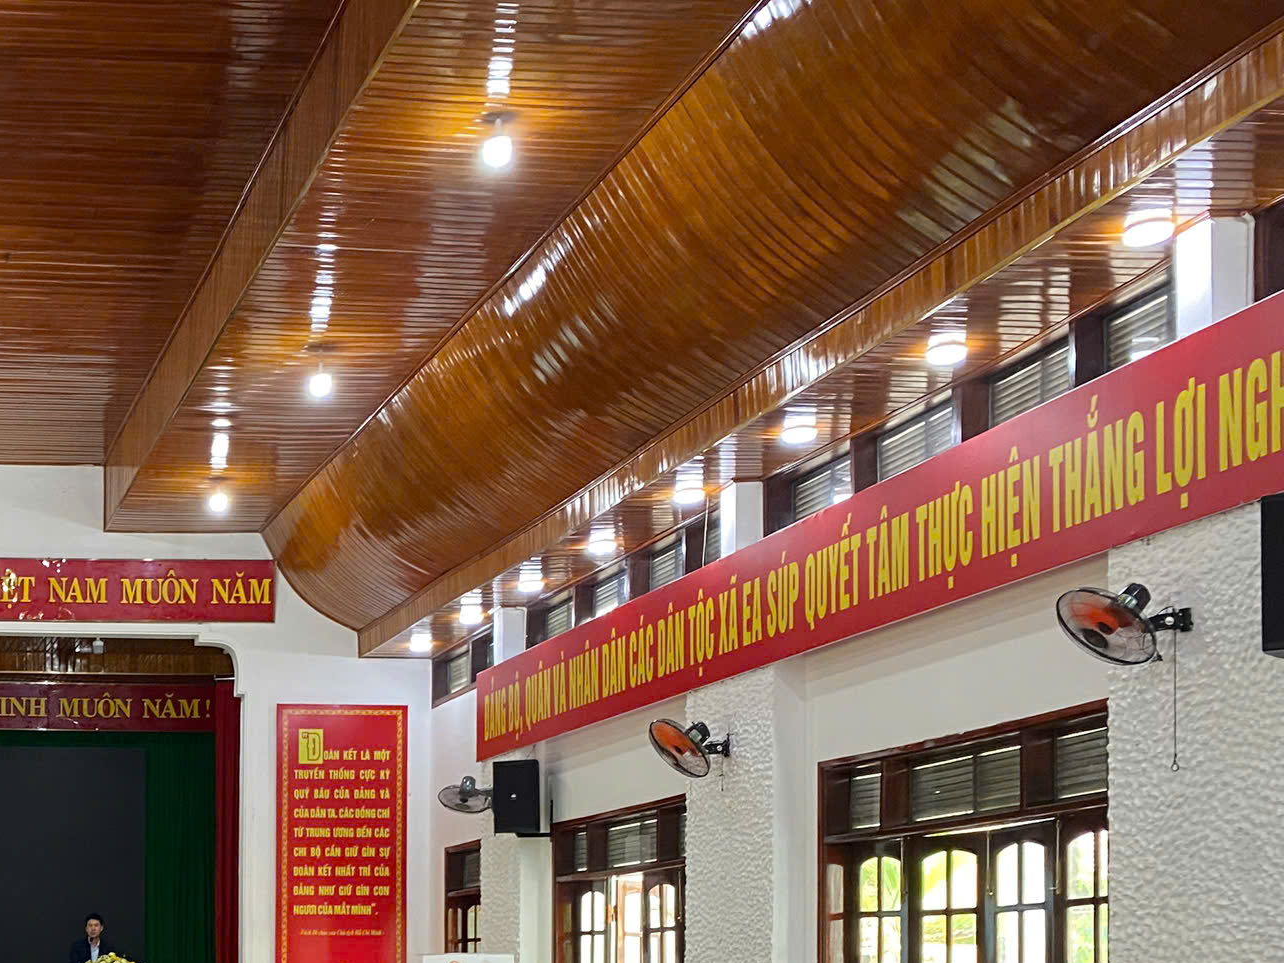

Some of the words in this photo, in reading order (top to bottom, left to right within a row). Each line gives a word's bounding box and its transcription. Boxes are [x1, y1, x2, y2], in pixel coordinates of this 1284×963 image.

[484, 676, 507, 741] ĐẢNG
[526, 663, 551, 731] QUÂN
[554, 651, 566, 718] VÀ
[569, 640, 600, 709] NHÂN
[602, 627, 626, 698] DÂN
[629, 616, 655, 688] CÁC
[658, 603, 685, 678] DÂN
[688, 589, 715, 677] TỘC
[718, 575, 738, 654] XÃ
[742, 577, 762, 646] EA
[767, 552, 800, 638] SÚP
[804, 512, 862, 631] QUYẾT
[866, 504, 910, 600] TÂM
[916, 481, 973, 590] THỰC
[981, 447, 1041, 568] HIỆN
[1049, 395, 1145, 534] THẮNG
[1156, 377, 1206, 509] LỢI
[49, 577, 109, 604] NAM
[120, 569, 199, 605] MUÔN
[211, 572, 272, 606] NĂM
[57, 693, 133, 718] MUÔN
